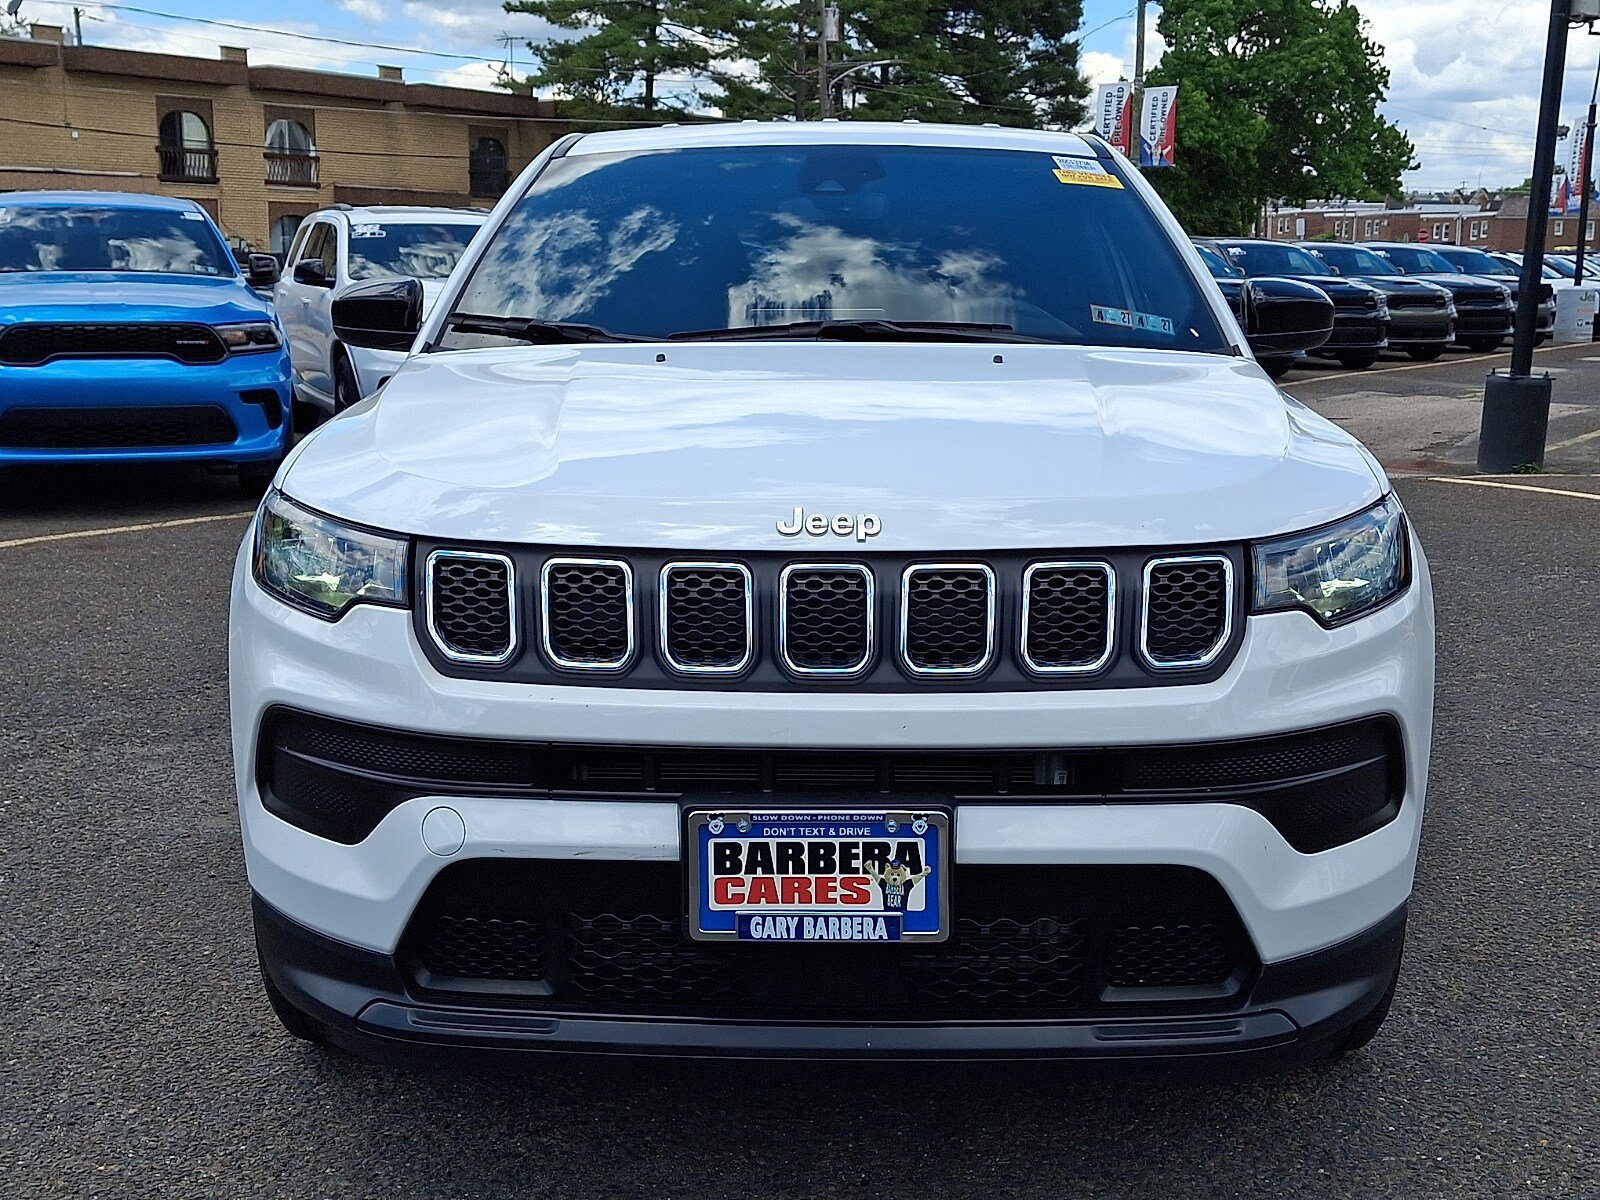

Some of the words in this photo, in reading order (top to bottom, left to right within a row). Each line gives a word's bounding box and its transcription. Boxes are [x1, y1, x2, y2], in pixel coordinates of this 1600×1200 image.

[1103, 91, 1113, 142] CERTIFIED
[1149, 96, 1159, 142] CERTIFIED
[1121, 312, 1130, 324] 27
[1161, 319, 1170, 331] 27
[776, 506, 882, 543] Jeep
[763, 827, 797, 836] DON'T
[799, 827, 826, 836] TEXT
[828, 827, 836, 836] &
[839, 827, 871, 836] DRIVE
[713, 841, 923, 875] BARBERA
[713, 876, 872, 905] CARES
[750, 916, 799, 939] GARY
[803, 916, 888, 940] BARBERA
